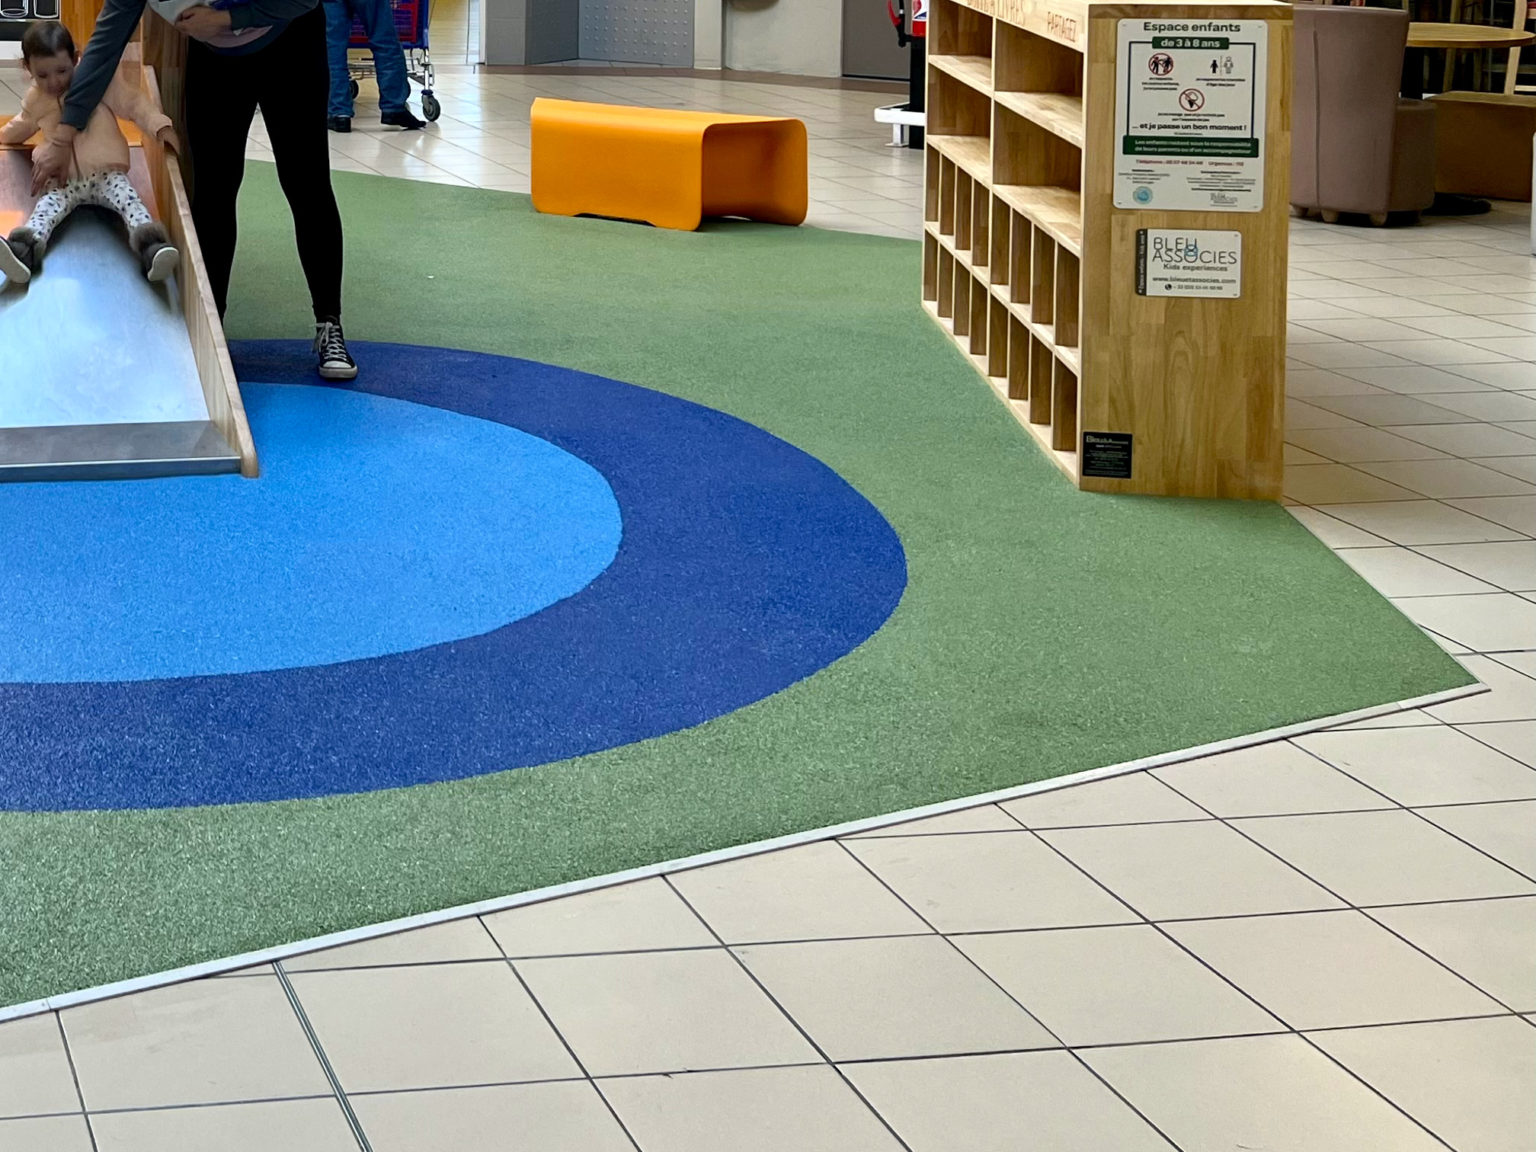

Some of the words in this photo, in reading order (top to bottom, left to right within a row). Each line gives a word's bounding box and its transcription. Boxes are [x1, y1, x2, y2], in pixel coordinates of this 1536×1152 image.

[1143, 21, 1189, 33] Espace
[1191, 22, 1241, 32] enfants
[1161, 38, 1175, 47] de
[1176, 38, 1183, 47] 3
[1184, 38, 1191, 47] à
[1192, 38, 1200, 48] 8
[1201, 40, 1220, 48] ans
[1153, 236, 1197, 250] BLEU
[1152, 249, 1237, 265] ASSOCIES
